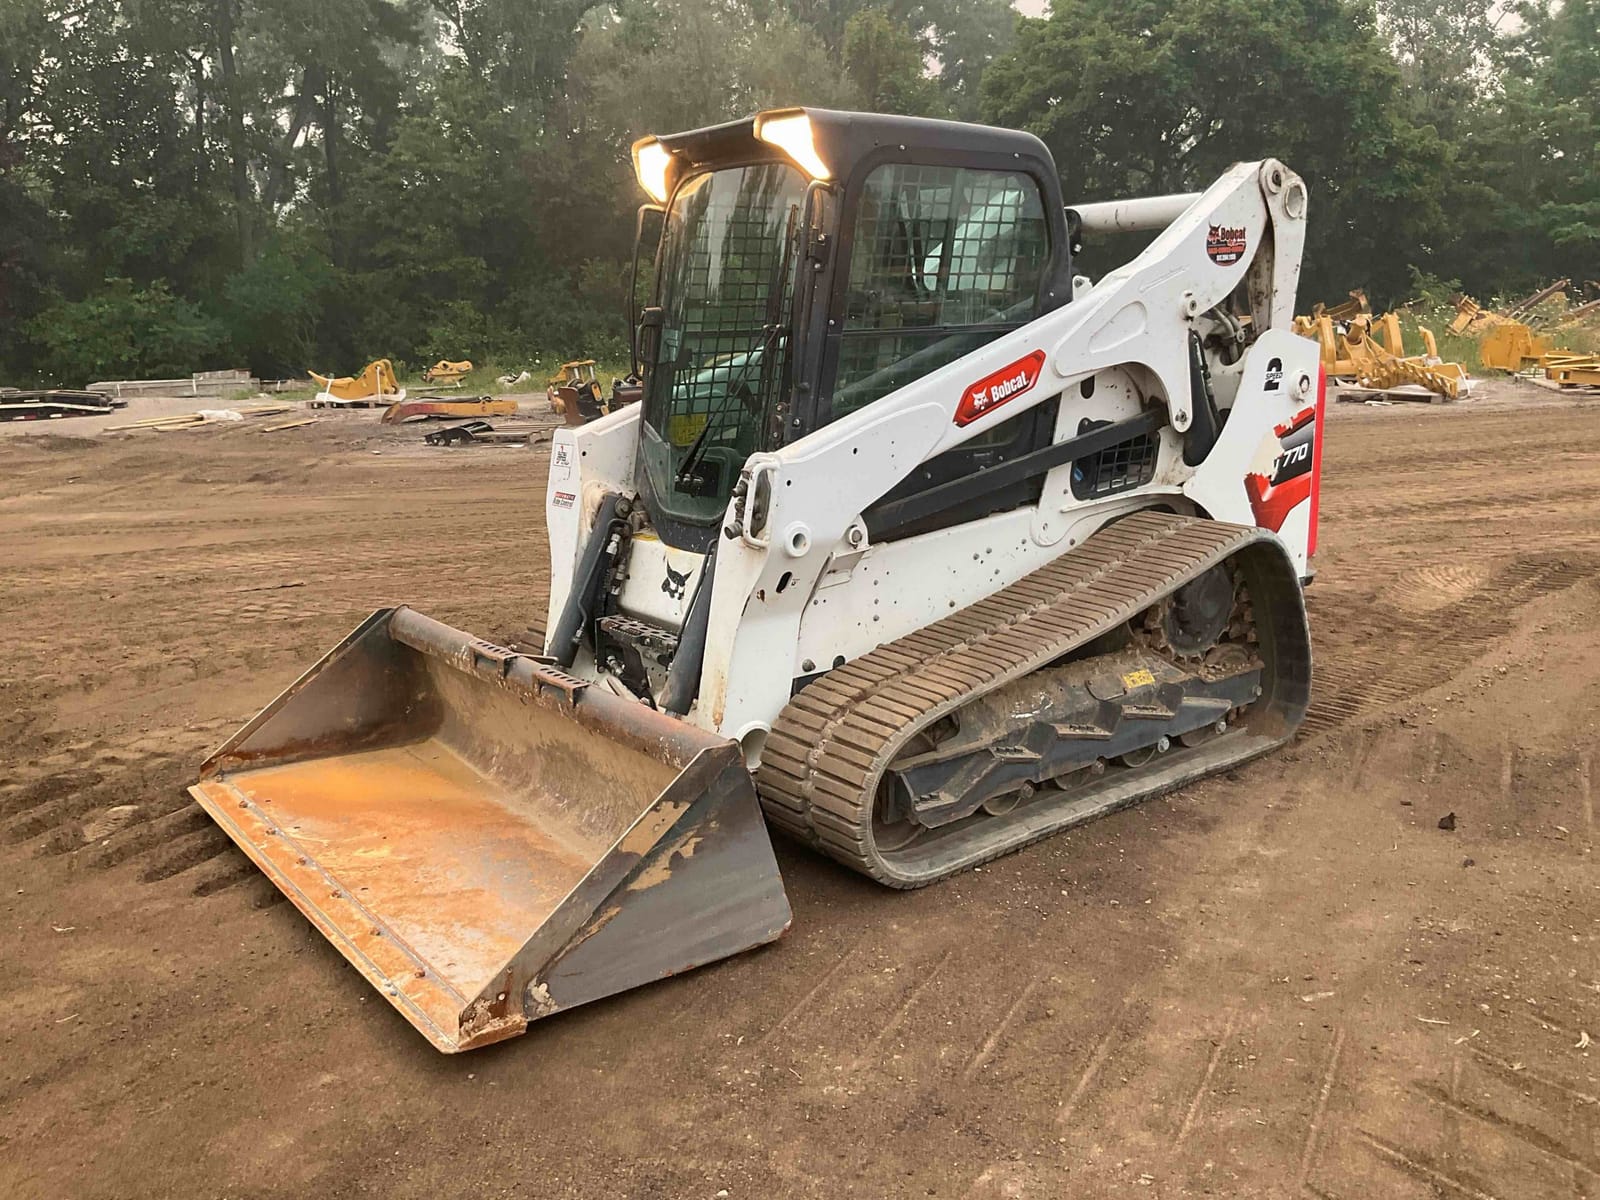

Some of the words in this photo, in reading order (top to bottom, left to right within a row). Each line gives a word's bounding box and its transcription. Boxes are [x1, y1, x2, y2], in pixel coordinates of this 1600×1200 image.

[1220, 227, 1246, 240] Bobcat
[1264, 358, 1282, 391] 2
[1265, 372, 1283, 380] SPEED
[991, 371, 1027, 402] Bobcat
